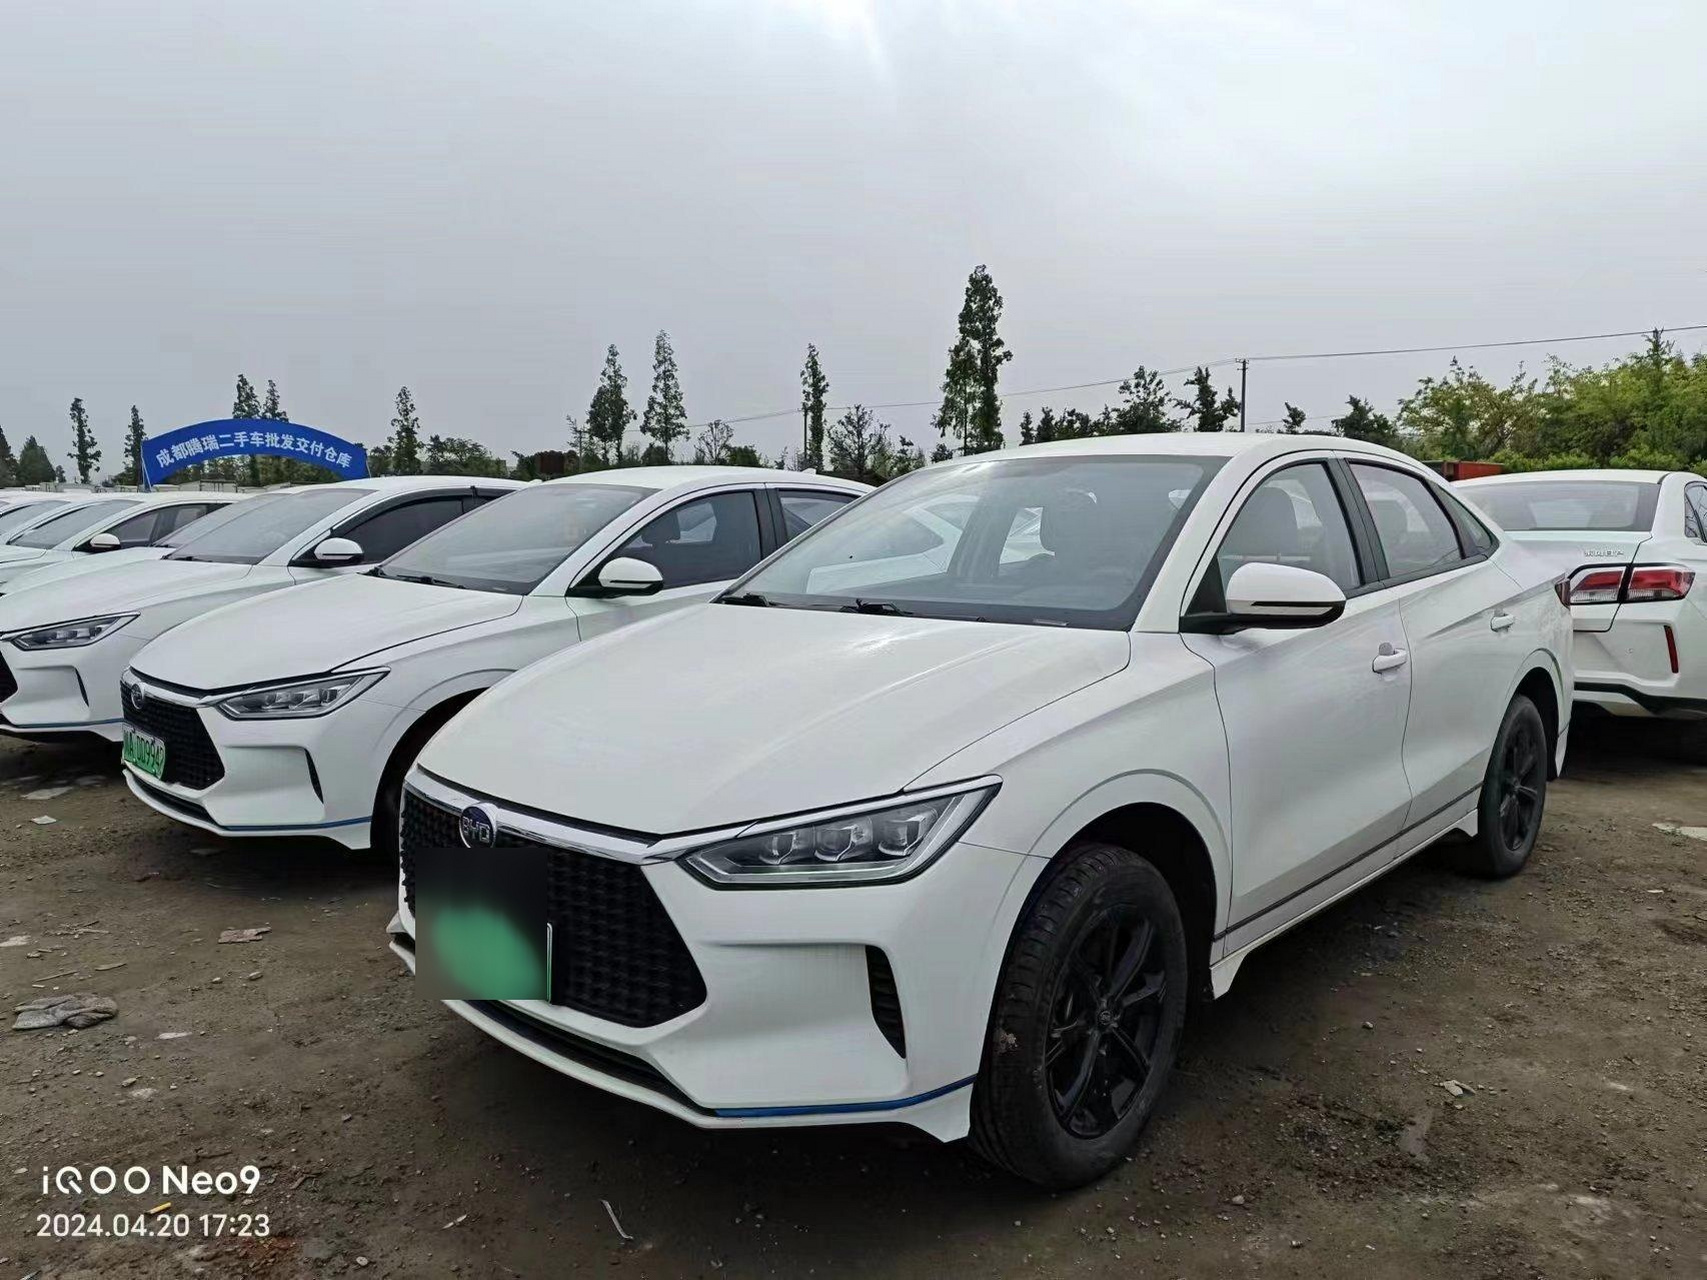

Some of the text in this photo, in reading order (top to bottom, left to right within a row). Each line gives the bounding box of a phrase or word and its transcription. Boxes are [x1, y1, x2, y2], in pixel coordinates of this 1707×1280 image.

[156, 431, 353, 469] 成都腾瑞二手车批发交付仓库
[462, 815, 490, 843] BYD
